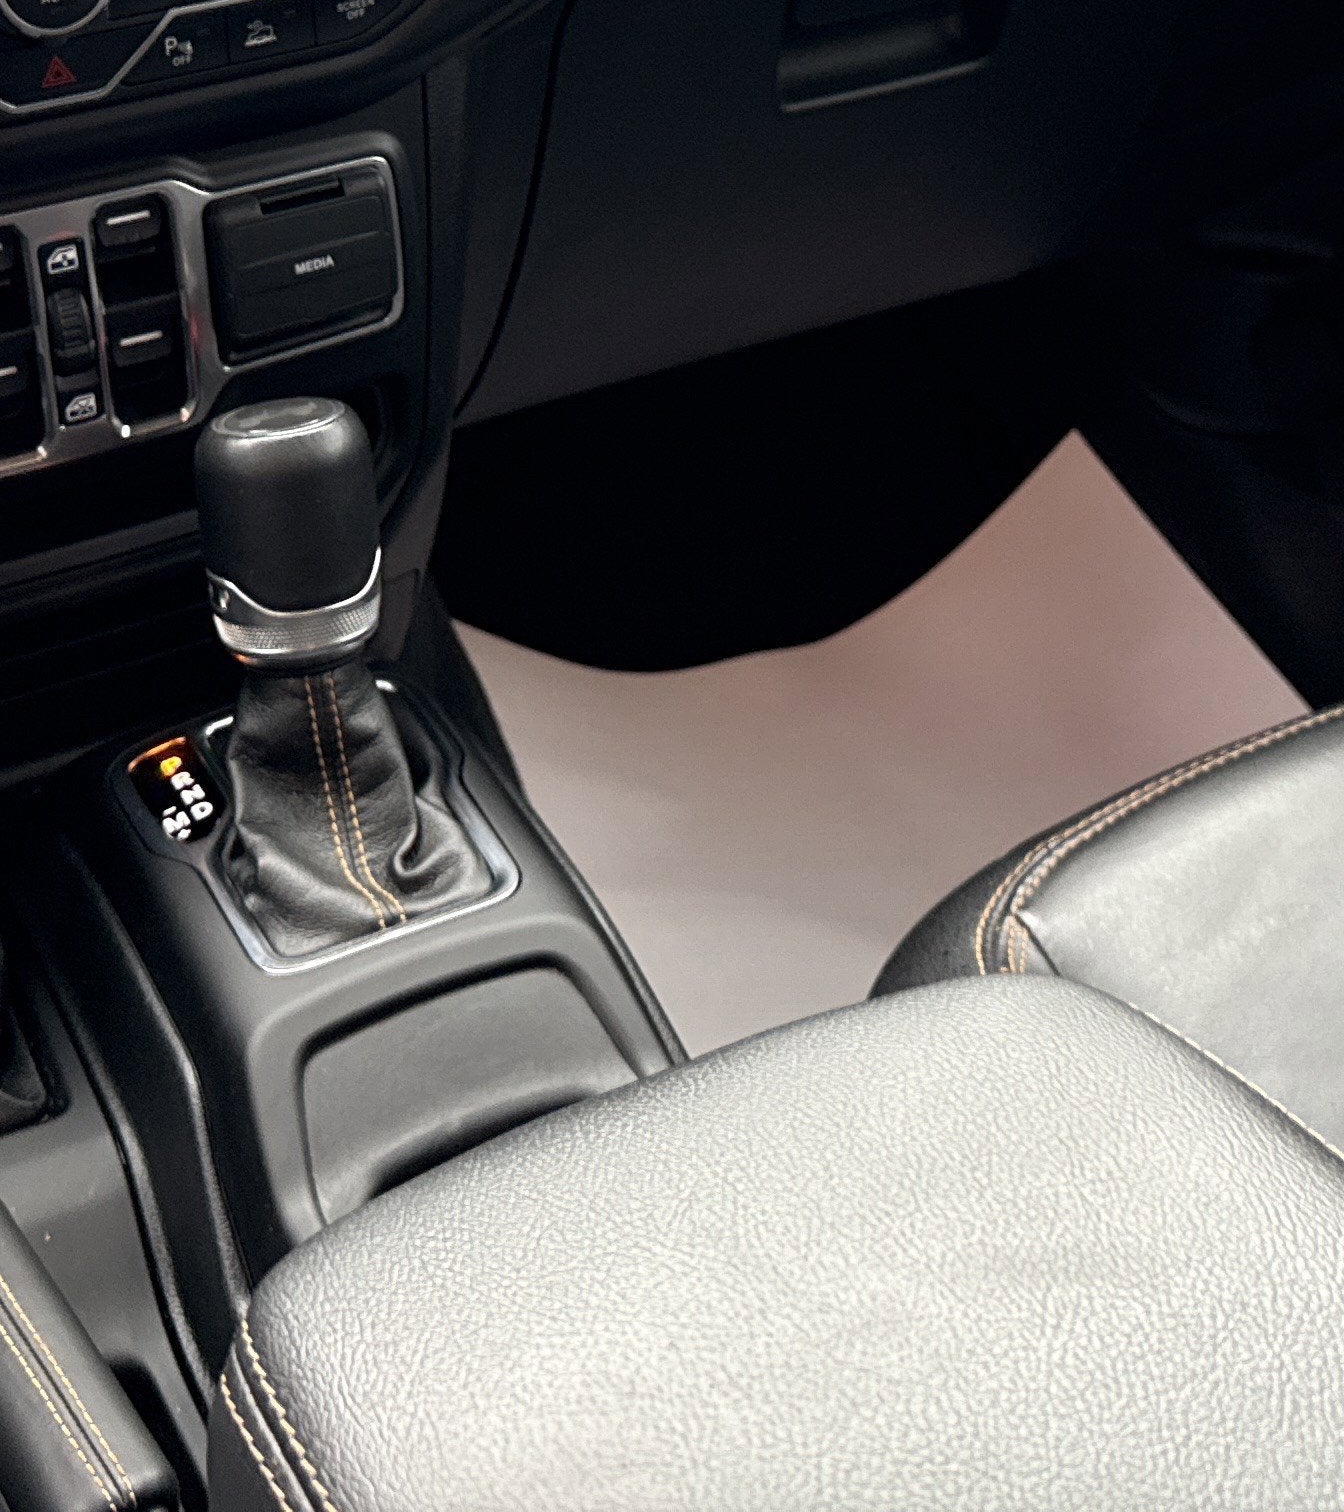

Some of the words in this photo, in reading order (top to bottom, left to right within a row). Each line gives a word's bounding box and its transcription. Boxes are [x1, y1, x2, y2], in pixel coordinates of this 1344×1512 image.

[294, 253, 335, 275] MEDIA
[160, 756, 182, 777] P
[171, 771, 195, 790] R
[180, 784, 205, 805] N
[190, 801, 213, 821] D
[162, 811, 191, 837] M
